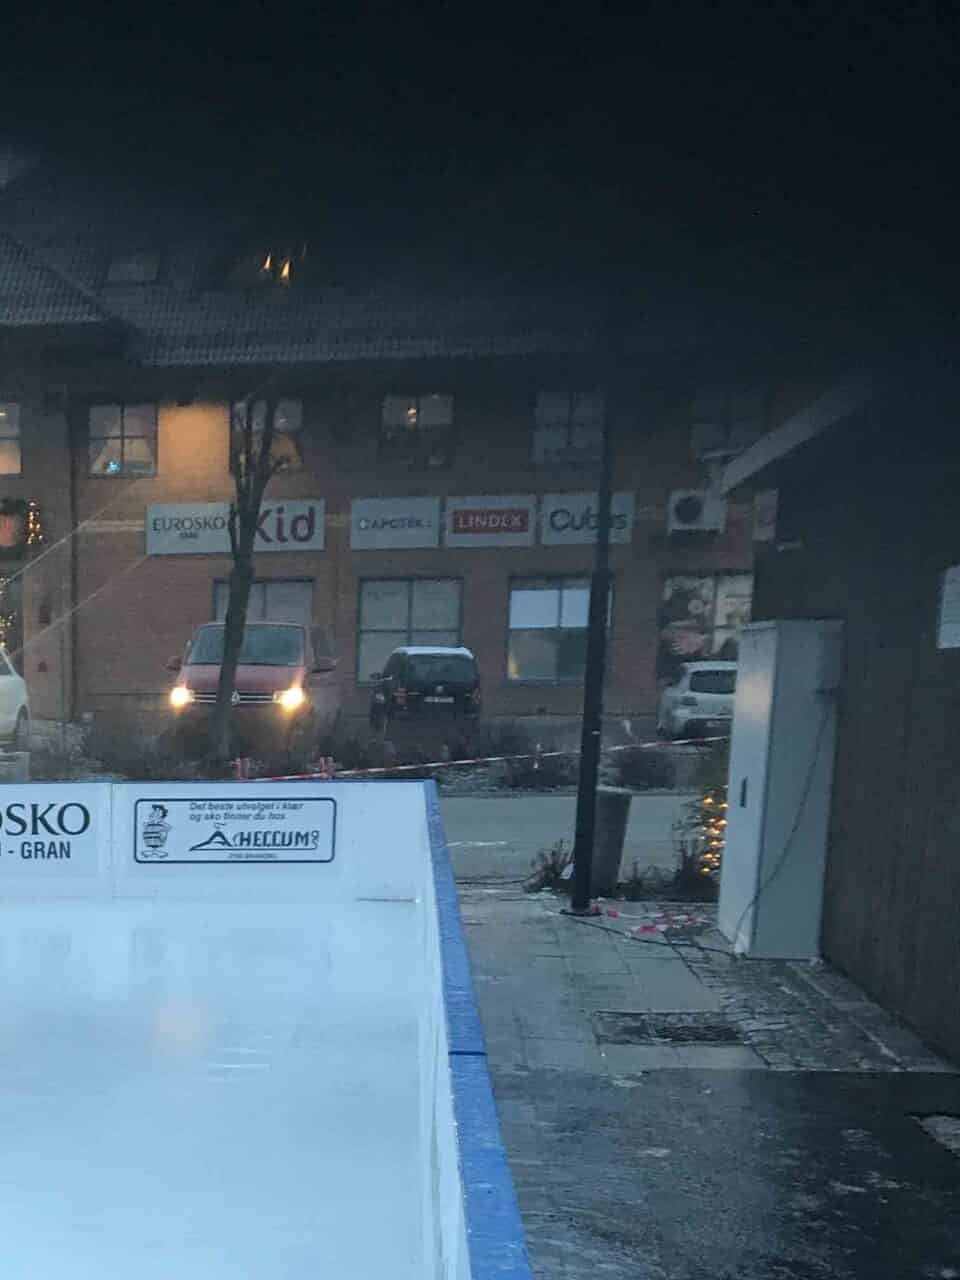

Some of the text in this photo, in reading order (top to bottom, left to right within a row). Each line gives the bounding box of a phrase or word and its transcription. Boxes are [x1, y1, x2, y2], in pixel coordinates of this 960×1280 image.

[152, 515, 226, 532] EUROSKO
[455, 514, 525, 530] LINDEX
[549, 506, 628, 531] Cubs
[20, 841, 72, 860] GRAN
